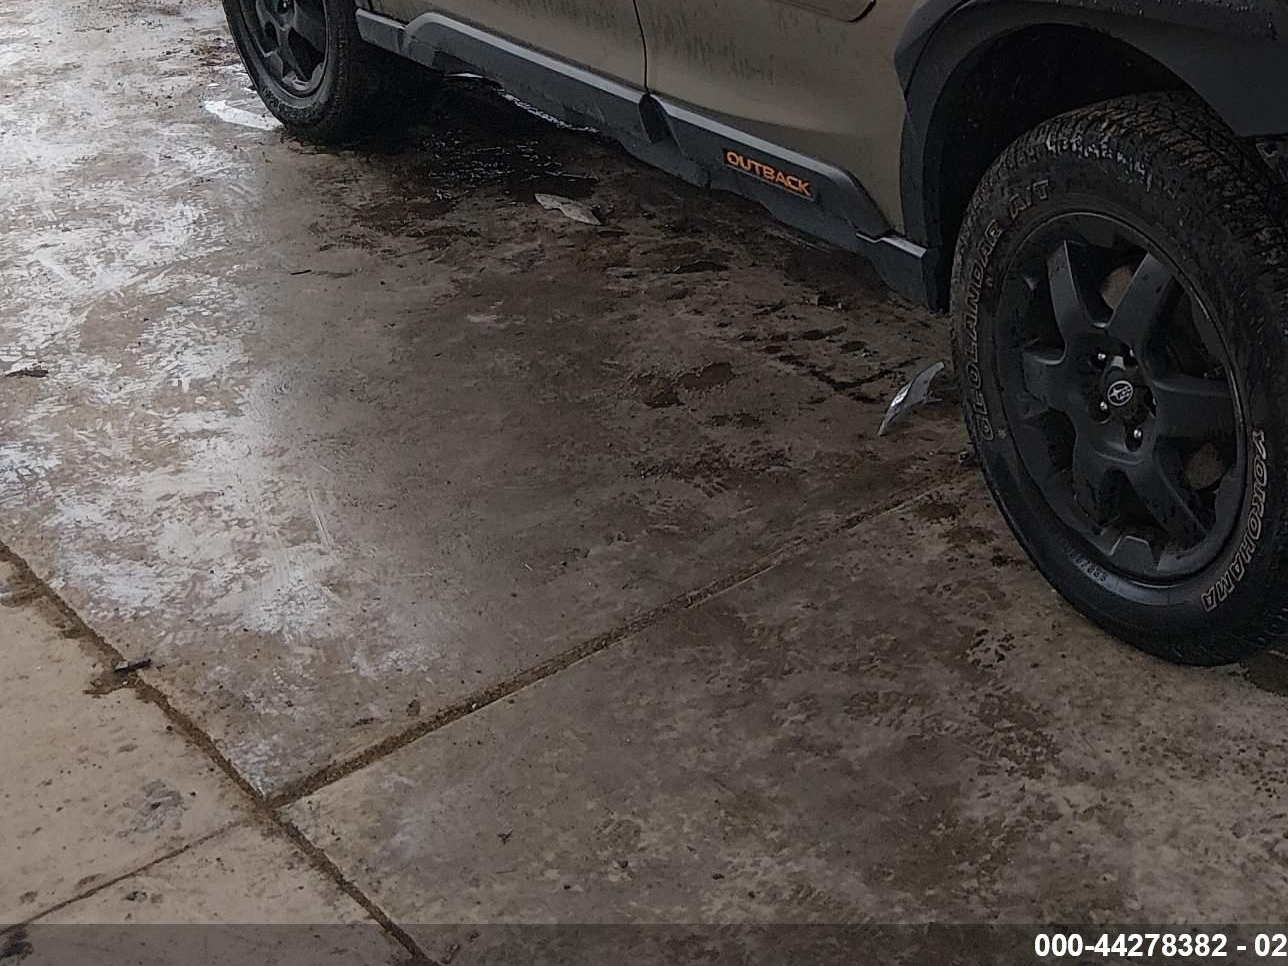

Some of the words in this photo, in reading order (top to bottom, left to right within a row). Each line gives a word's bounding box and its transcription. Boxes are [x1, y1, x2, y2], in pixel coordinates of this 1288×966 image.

[726, 151, 812, 197] OUTBACK
[963, 218, 1004, 442] GEOLANDAR
[1008, 179, 1050, 220] A/T
[1201, 429, 1268, 612] YOKOHAMA
